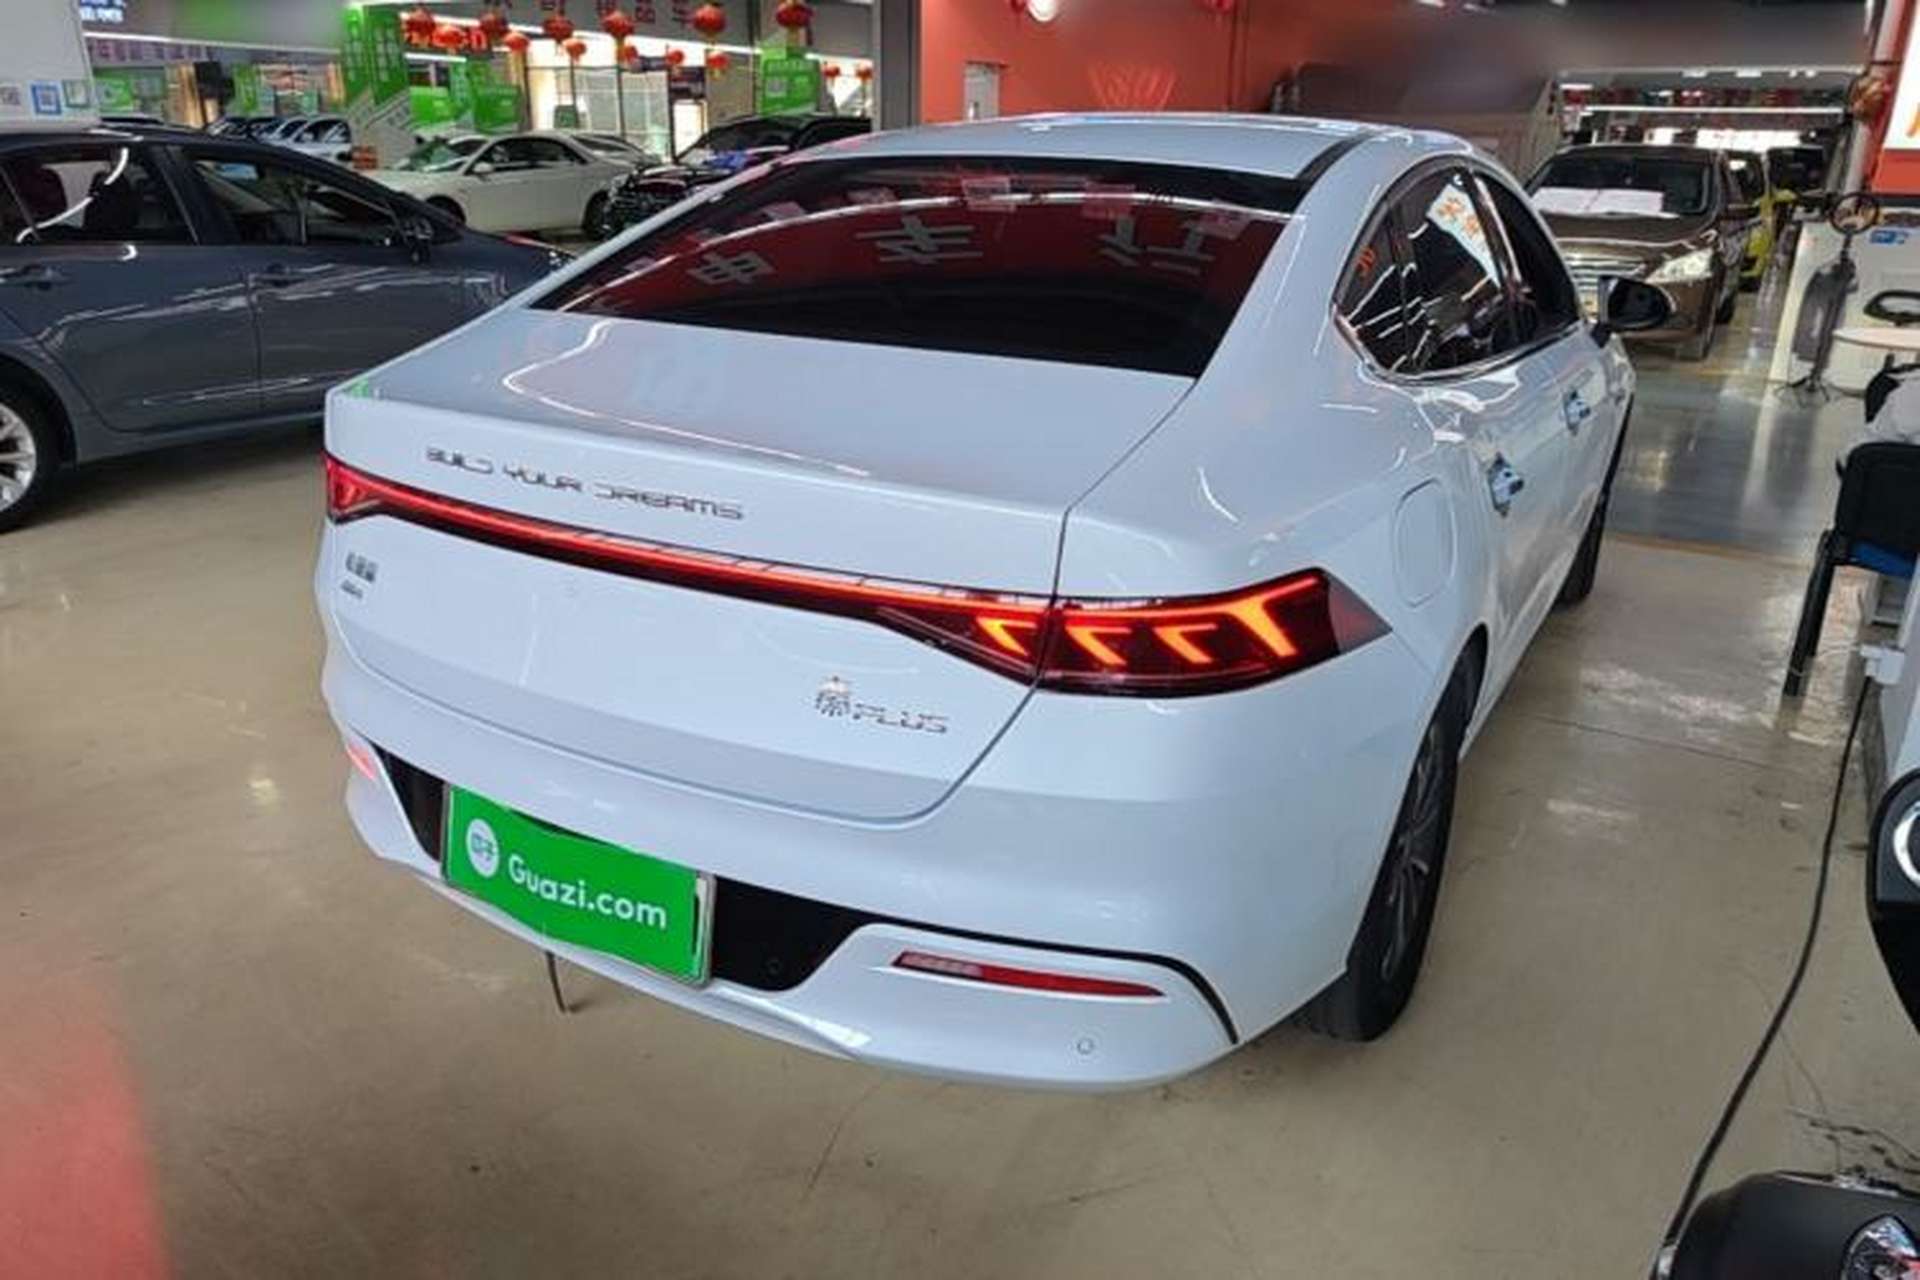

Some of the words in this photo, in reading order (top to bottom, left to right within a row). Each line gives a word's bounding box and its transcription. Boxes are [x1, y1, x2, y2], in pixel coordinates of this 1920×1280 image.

[426, 449, 495, 475] BUILD
[502, 461, 583, 493] YOUR
[593, 482, 745, 520] DREAMS
[508, 853, 667, 930] Guazi.com
